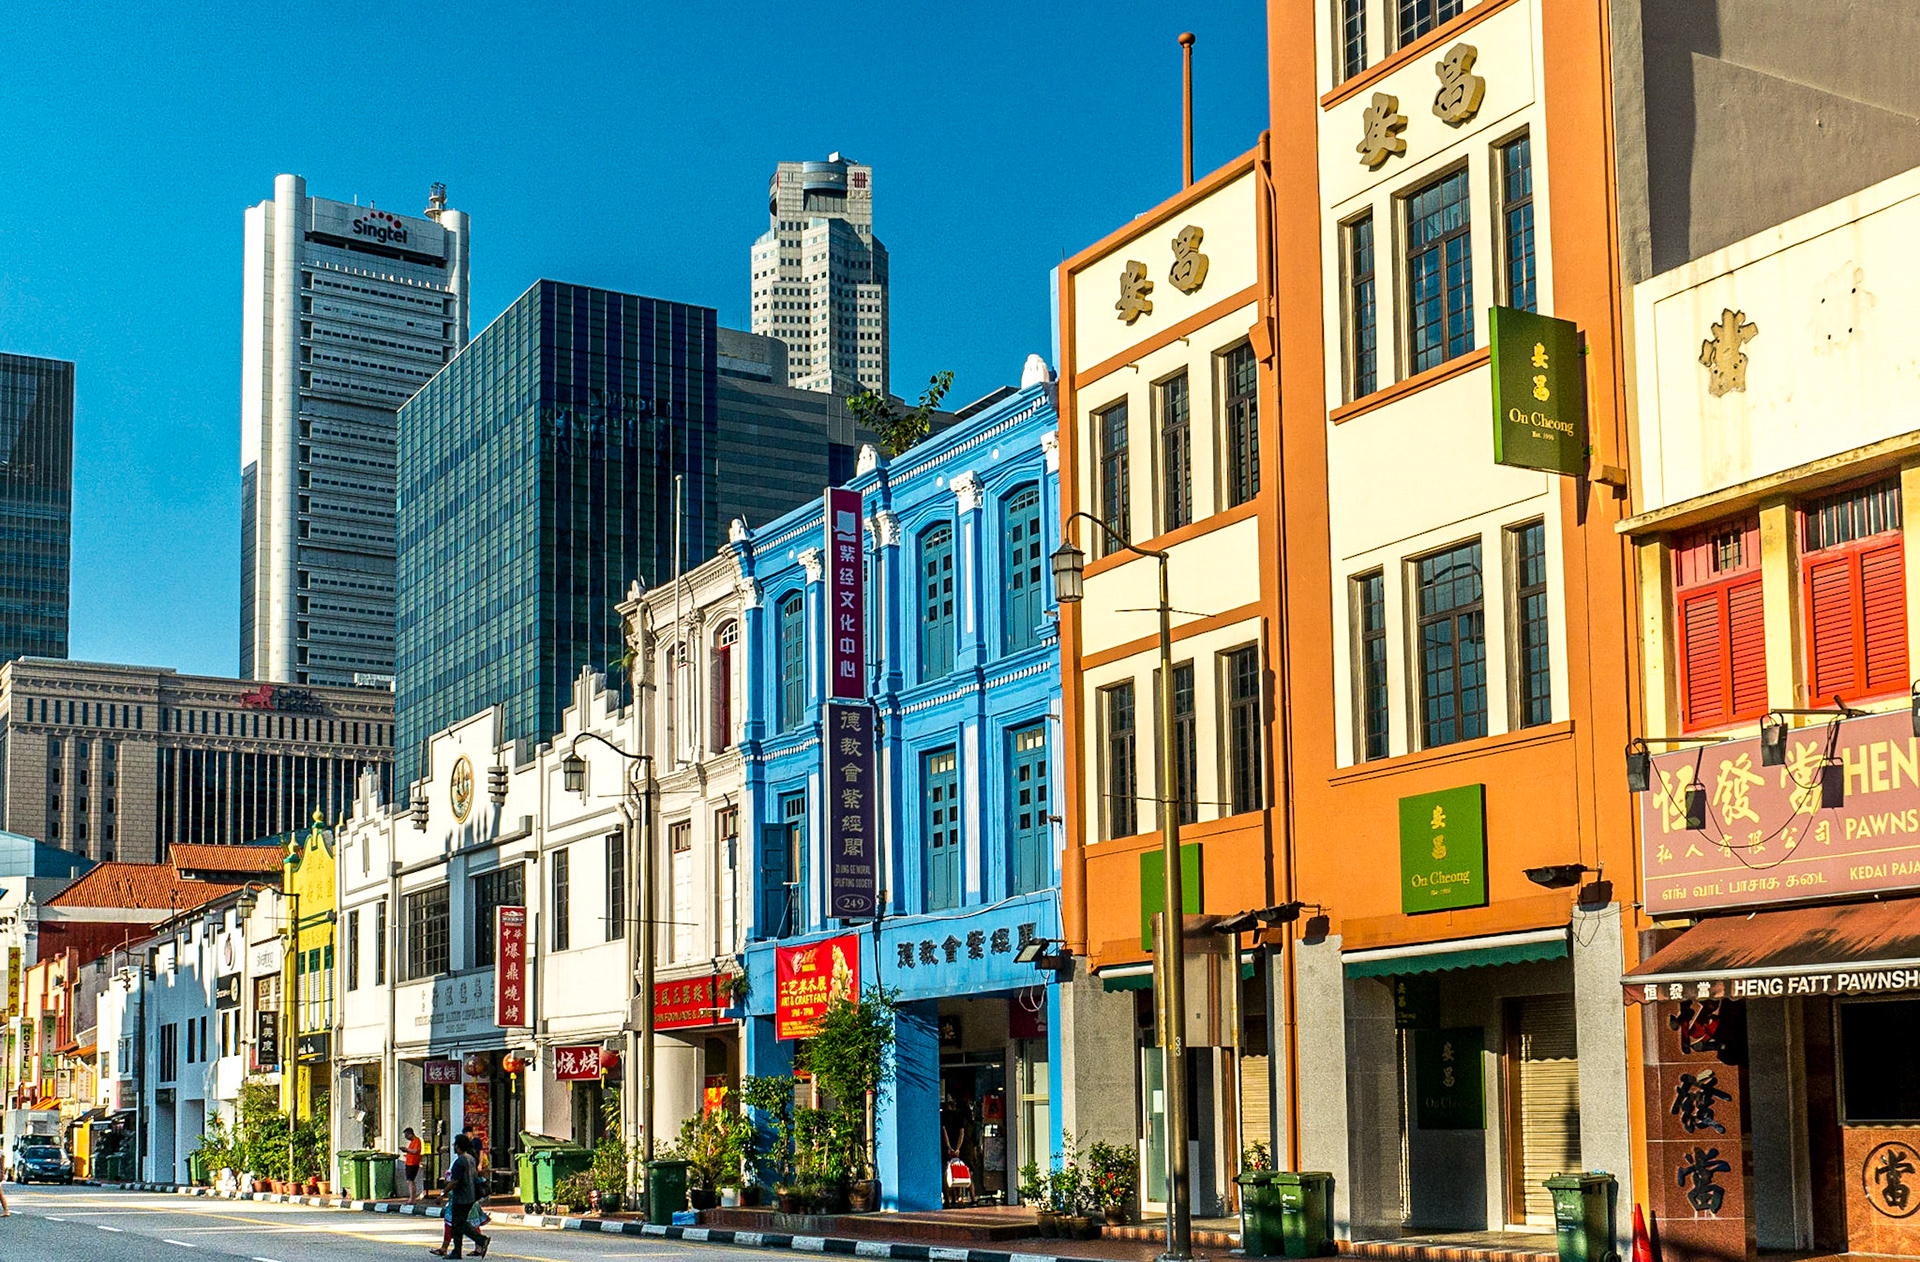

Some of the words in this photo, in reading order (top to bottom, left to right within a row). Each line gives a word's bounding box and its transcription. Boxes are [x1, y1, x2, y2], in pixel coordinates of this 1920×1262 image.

[353, 218, 407, 244] Singtel
[1509, 407, 1529, 424] On
[1531, 411, 1575, 437] Cheong
[839, 545, 856, 679] 紫经文化中心
[277, 686, 311, 700] Great
[277, 697, 323, 714] Eastern
[1842, 736, 1920, 796] HEN
[1845, 808, 1920, 841] PAWNS
[1656, 821, 1831, 865] 私人有限公司
[856, 879, 873, 889] SOCIETY
[1412, 874, 1428, 888] On
[1430, 870, 1470, 885] Cheong
[1850, 863, 1887, 881] KEDAI
[844, 898, 864, 908] 249
[1734, 977, 1784, 997] HENG
[1788, 974, 1832, 994] FATT
[1837, 969, 1920, 991] PAWNSH
[795, 994, 813, 1006] CRAFT
[814, 993, 827, 1004] FAIR
[23, 1027, 31, 1069] HOSTEL
[557, 1049, 599, 1075] 烧烤
[1875, 1147, 1916, 1210] 當
